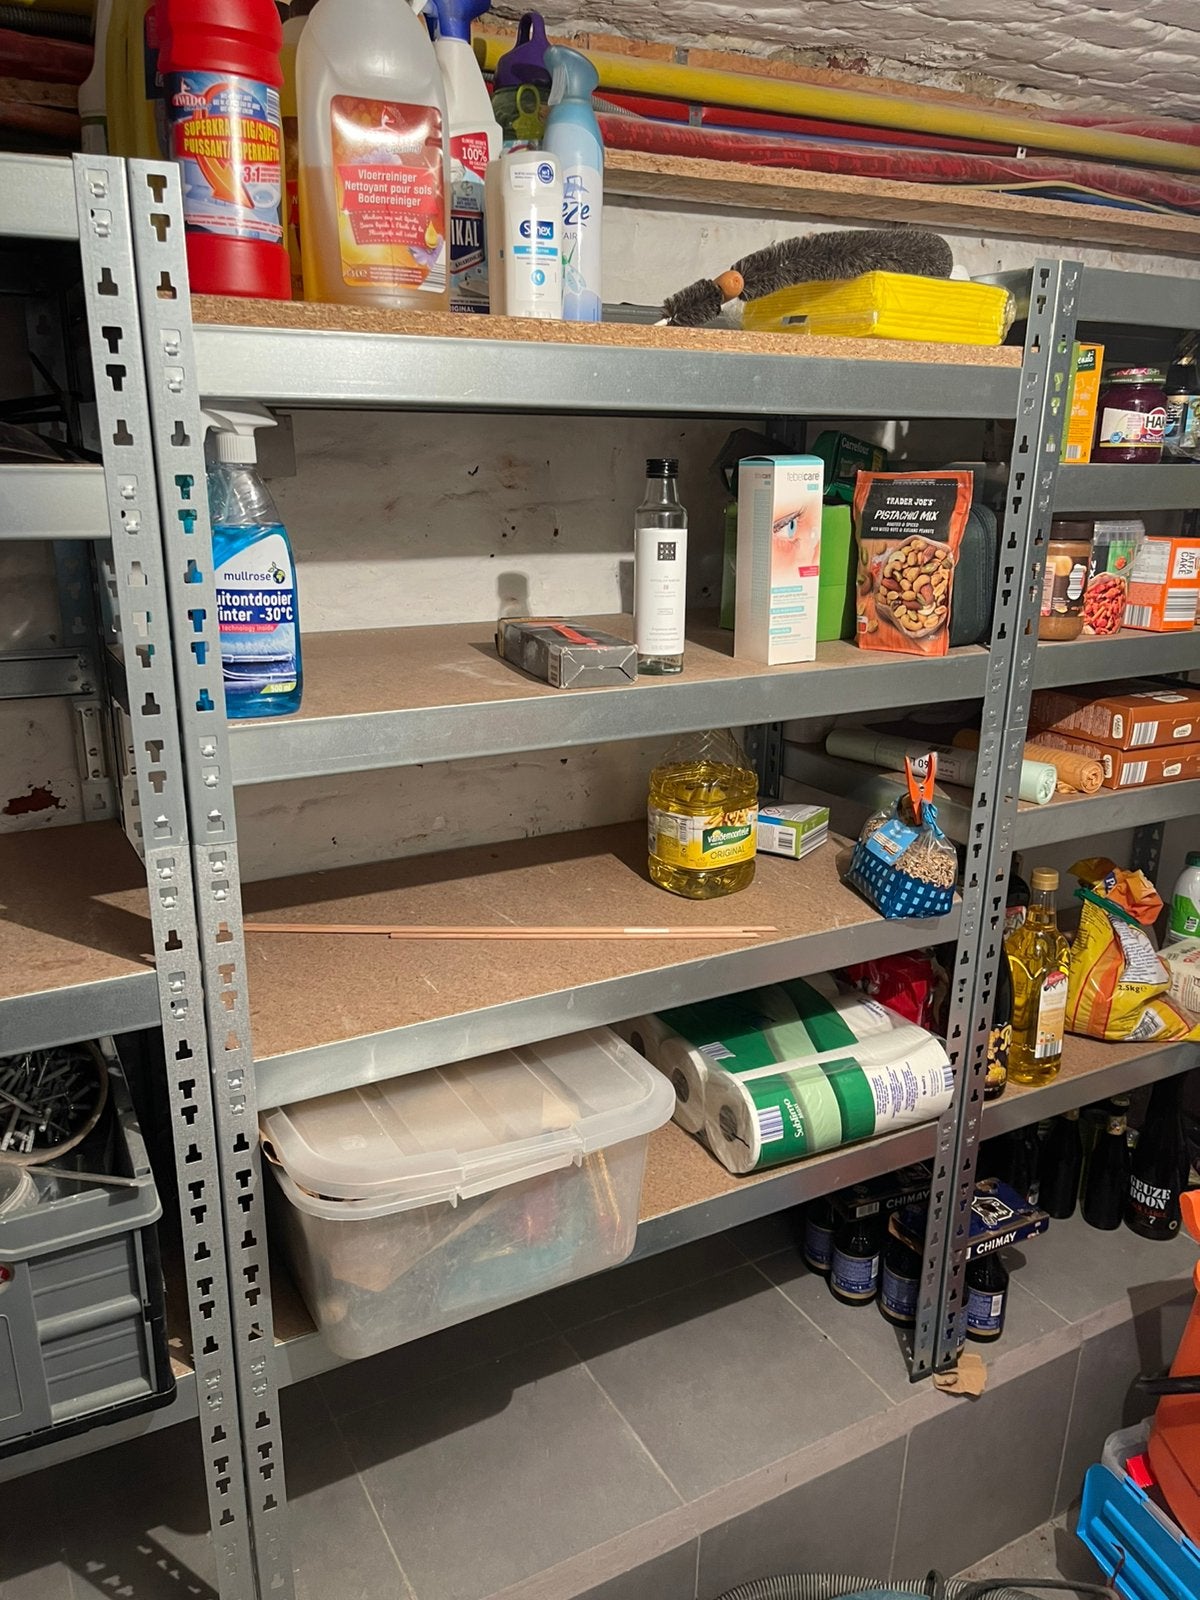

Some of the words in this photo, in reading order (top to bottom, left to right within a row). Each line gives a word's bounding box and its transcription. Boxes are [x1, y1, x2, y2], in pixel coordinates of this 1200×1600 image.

[462, 147, 487, 162] 100%
[358, 169, 418, 185] Vloerreiniger
[344, 180, 388, 193] Nettoyant
[390, 185, 412, 195] pour
[413, 185, 433, 195] sols
[358, 193, 422, 208] Bodenreiniger
[523, 222, 552, 237] Snex
[450, 303, 476, 314] IGINAL
[886, 497, 913, 506] TRADER
[874, 510, 920, 521] PISTACHIO
[920, 510, 940, 521] MIX
[1178, 551, 1189, 575] CAKE
[224, 571, 271, 581] mullrose
[217, 607, 254, 622] inter
[259, 606, 294, 622] -30°C
[711, 845, 745, 860] ORIGINAL
[1130, 1175, 1171, 1200] GEUZE
[886, 1190, 931, 1209] CHIMAY
[1130, 1186, 1167, 1210] BOON
[1149, 1215, 1157, 1224] 7
[976, 1231, 1017, 1255] CHIMAY
